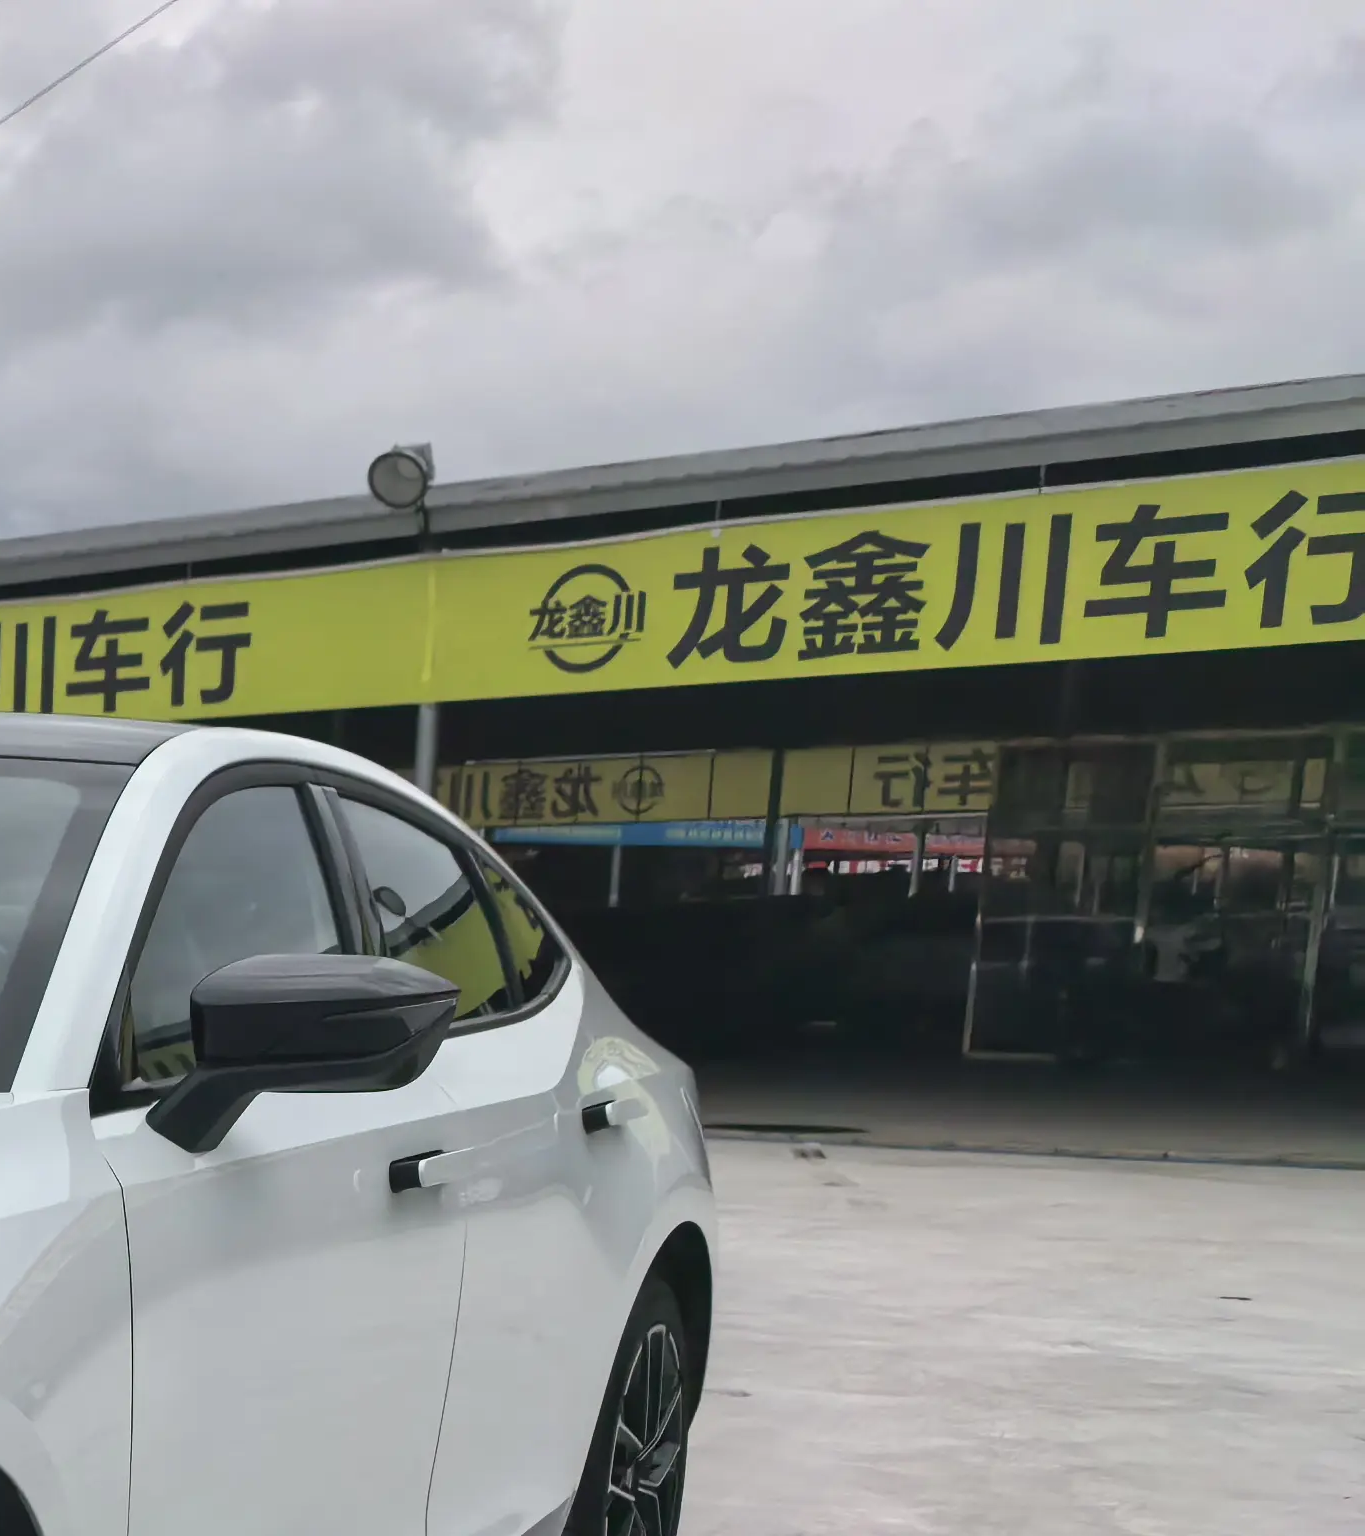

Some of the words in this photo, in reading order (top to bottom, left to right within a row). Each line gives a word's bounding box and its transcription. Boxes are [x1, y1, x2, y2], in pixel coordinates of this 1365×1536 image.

[528, 590, 647, 642] 龙鑫川
[667, 489, 1365, 668] 龙鑫川车行
